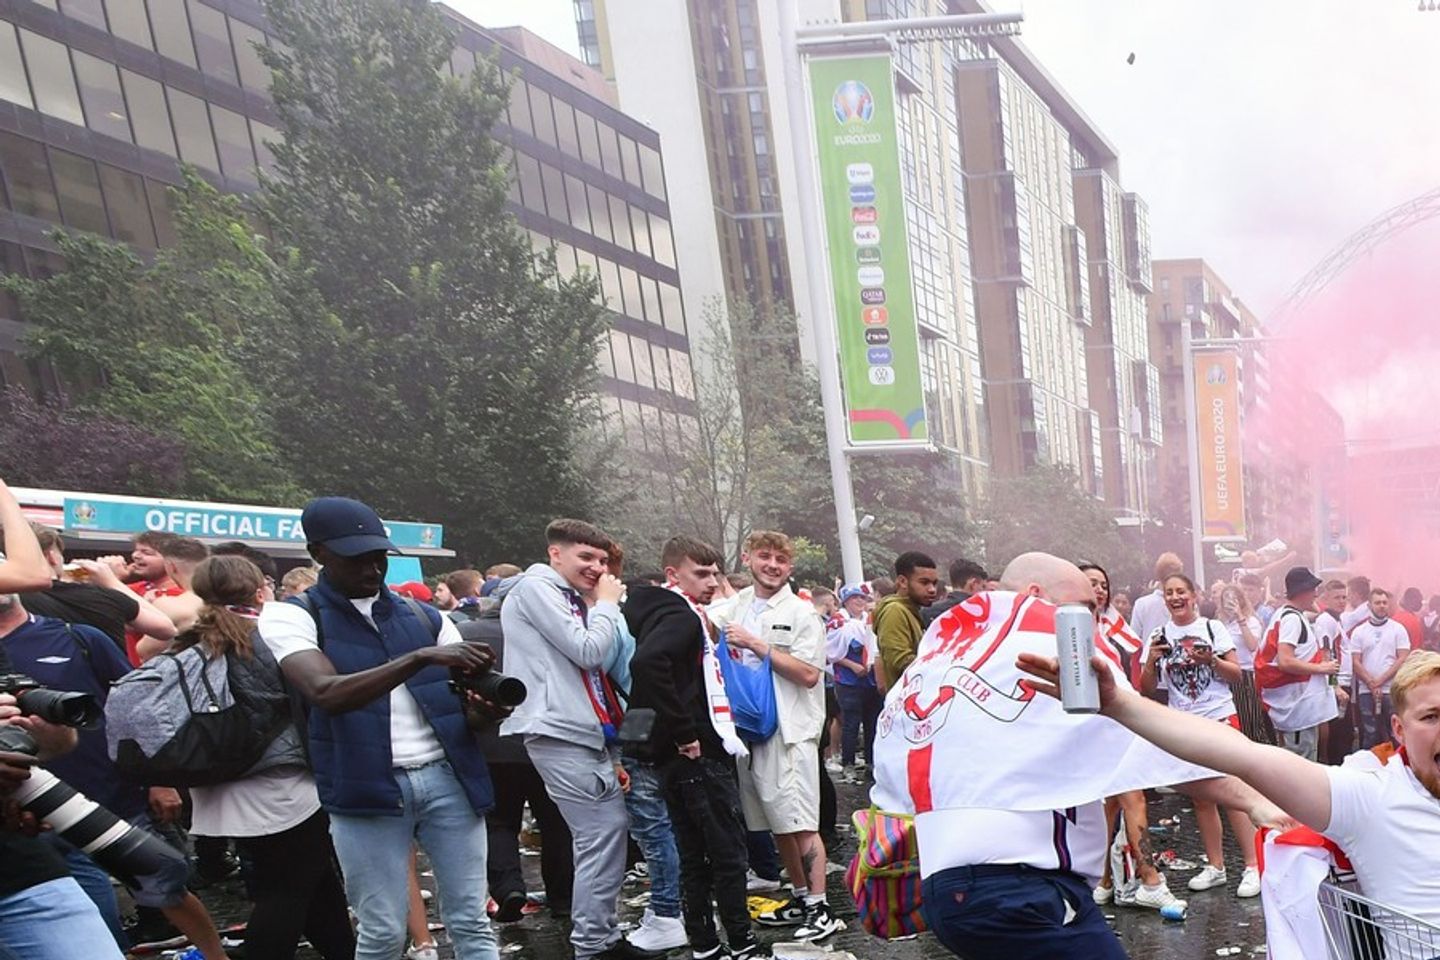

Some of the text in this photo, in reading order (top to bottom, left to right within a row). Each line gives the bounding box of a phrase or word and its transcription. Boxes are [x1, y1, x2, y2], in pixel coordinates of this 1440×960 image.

[1212, 397, 1229, 511] UEFA EURO 2020
[145, 509, 270, 538] OFFICIAL
[957, 673, 992, 703] CLUB
